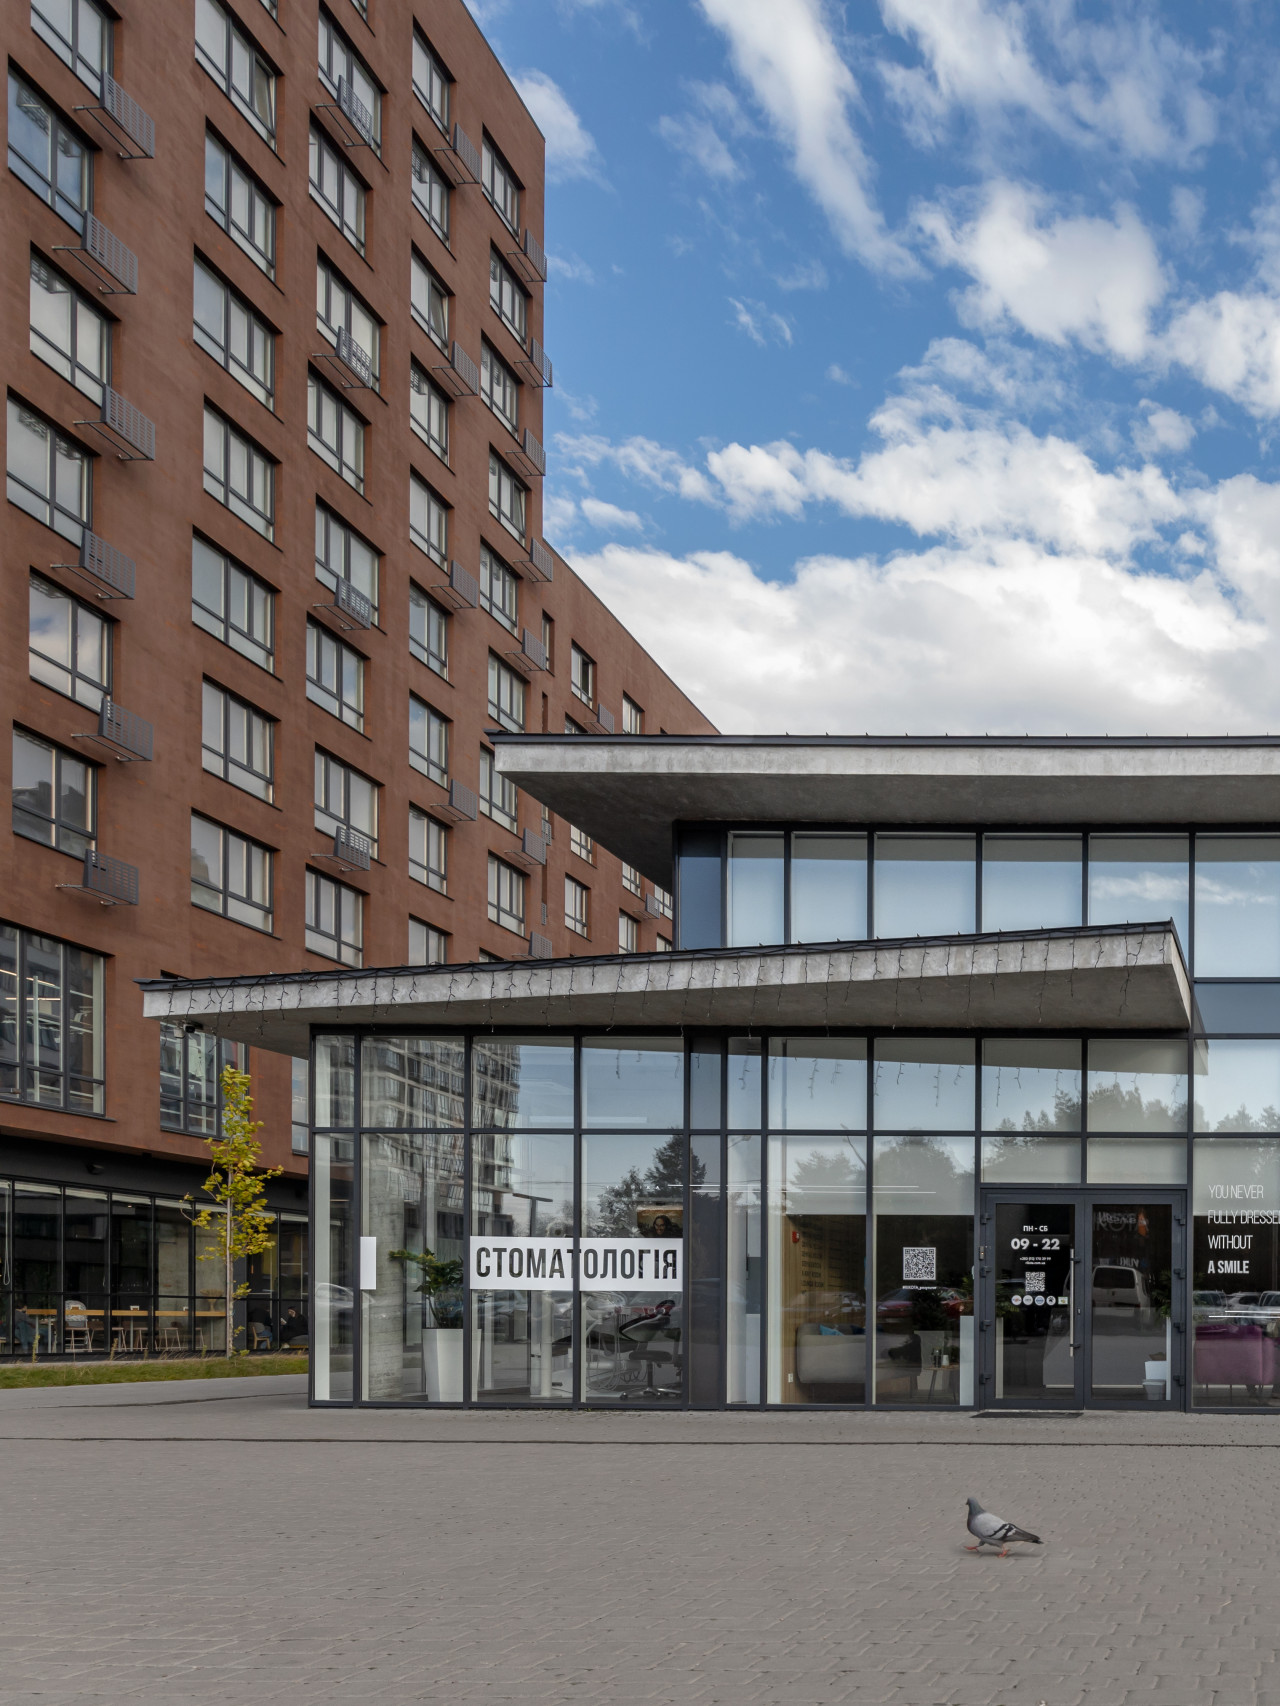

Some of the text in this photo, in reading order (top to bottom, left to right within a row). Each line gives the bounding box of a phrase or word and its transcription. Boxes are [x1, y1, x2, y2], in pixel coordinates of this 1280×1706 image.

[1208, 1184, 1264, 1199] YOU NEVER
[1207, 1209, 1239, 1225] FULLY
[1010, 1238, 1030, 1250] 09
[1041, 1238, 1060, 1250] 22
[1207, 1234, 1254, 1250] WITHOUT
[476, 1246, 678, 1280] СТОМАТОЛОГІЯ
[1207, 1260, 1250, 1274] A SMILE
